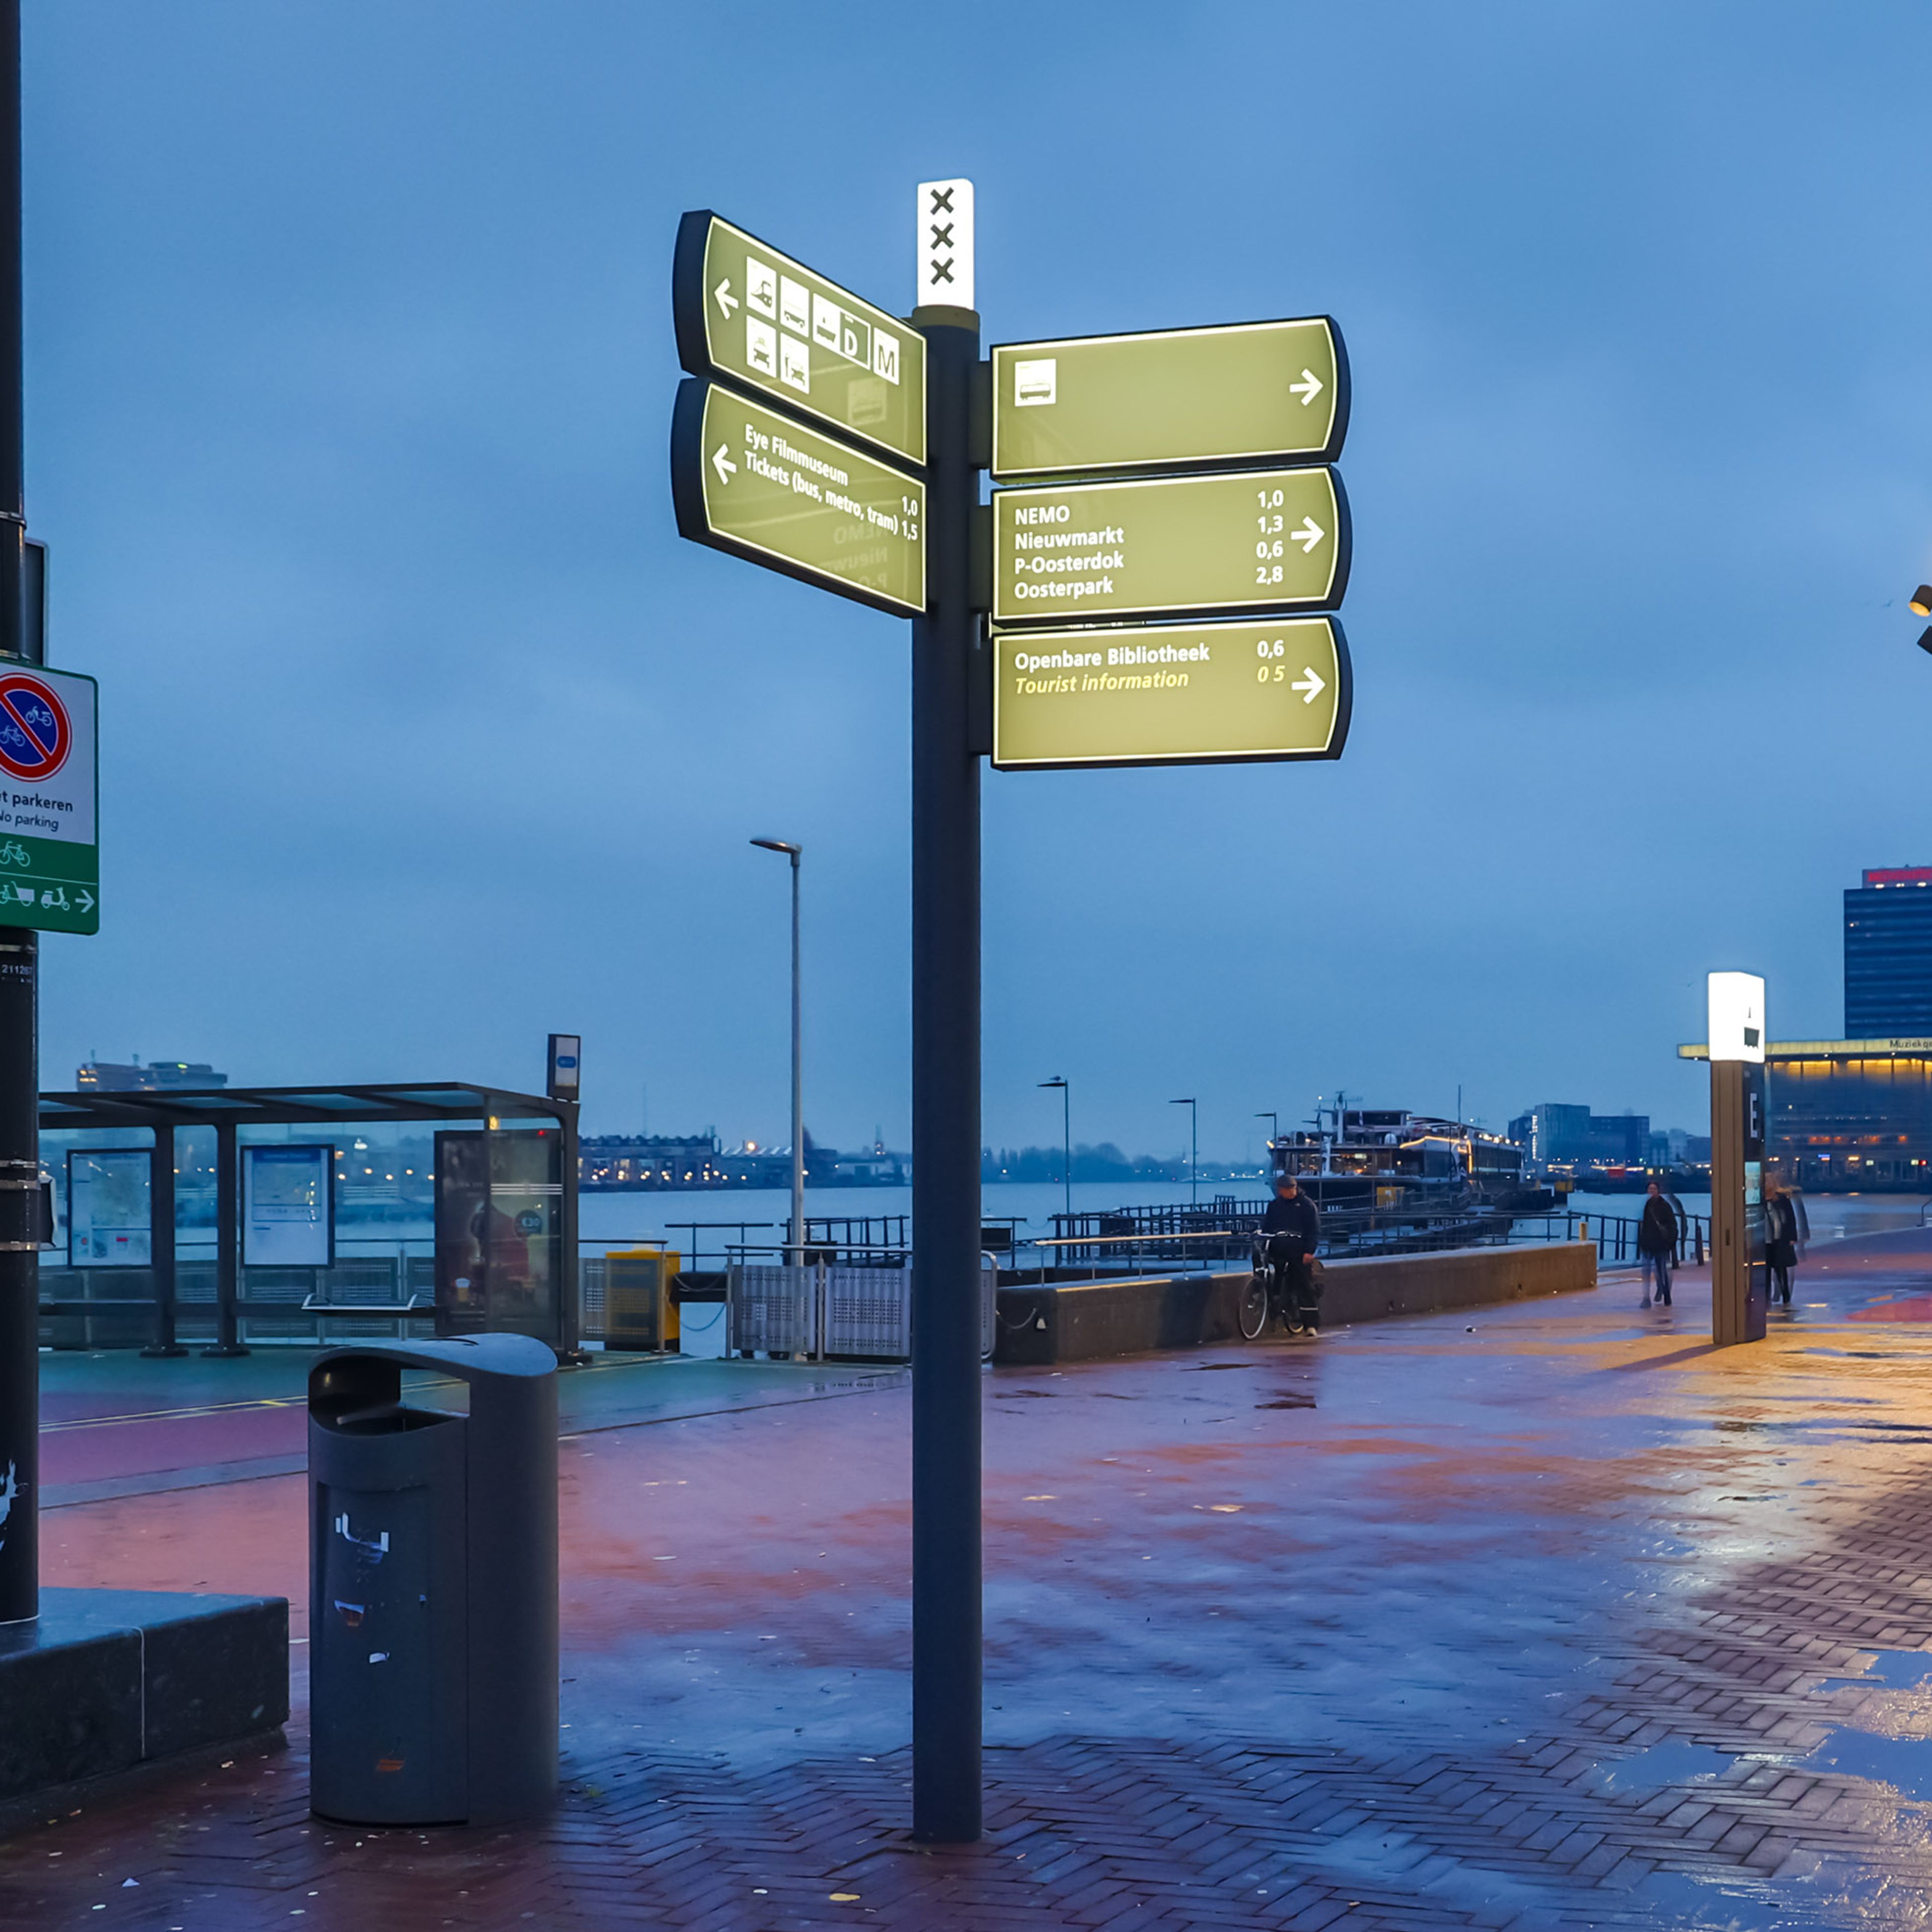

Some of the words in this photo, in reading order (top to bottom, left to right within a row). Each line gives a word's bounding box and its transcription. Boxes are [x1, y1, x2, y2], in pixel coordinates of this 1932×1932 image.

[878, 344, 895, 377] M
[746, 424, 768, 450] Eye
[772, 436, 848, 486] Filmmuseum
[745, 450, 789, 486] Tickets
[792, 471, 822, 503] (bus,
[826, 490, 864, 521] metro,
[867, 506, 899, 535] tram)
[902, 520, 918, 540] 1,5
[1257, 490, 1283, 510] 1,0
[902, 496, 918, 516] 1,0
[1015, 505, 1070, 525] NEMO
[1257, 515, 1283, 534] 1,3
[1015, 526, 1124, 549] Nieuwmarkt
[1256, 540, 1283, 560] 0,6
[1015, 550, 1124, 574] P-Oosterdok
[1256, 566, 1283, 585] 2,8
[1015, 576, 1113, 599] Oosterpark
[1015, 649, 1102, 673] Openbare
[1107, 642, 1210, 666] Bibliotheek
[1257, 639, 1284, 659] 0,6
[1016, 675, 1077, 694] Tourist
[1082, 670, 1189, 691] information
[13, 793, 73, 812] parkeren
[15, 815, 58, 832] parking
